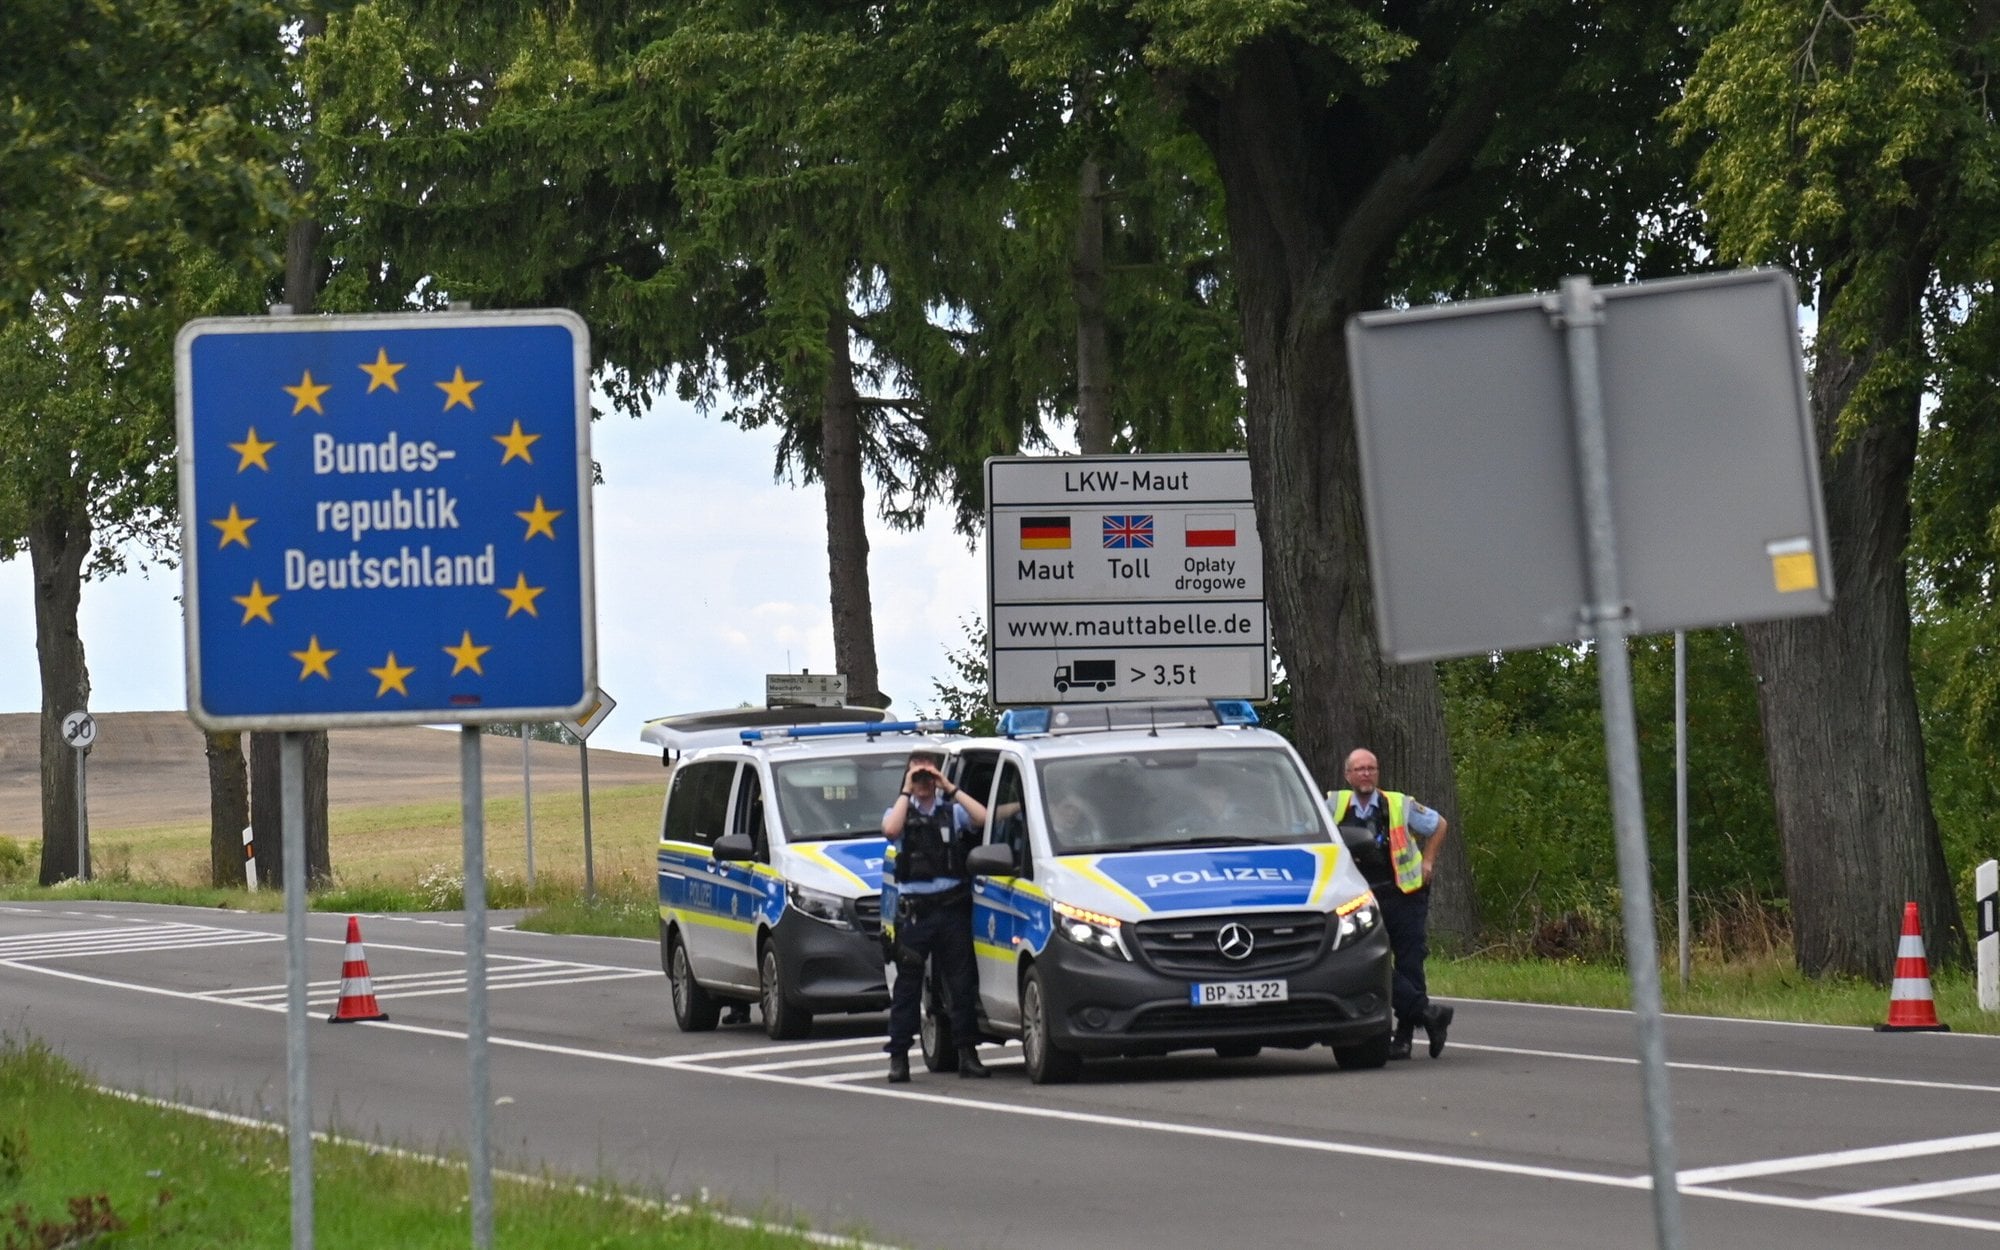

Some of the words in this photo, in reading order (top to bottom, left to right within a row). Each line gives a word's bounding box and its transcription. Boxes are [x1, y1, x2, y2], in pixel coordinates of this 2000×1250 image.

[313, 431, 456, 475] Bundes-
[1065, 470, 1189, 492] LKW-Maut
[316, 487, 460, 542] republik
[284, 543, 496, 591] Deutschland
[1018, 559, 1075, 580] Maut
[1107, 558, 1150, 579] Toll
[1175, 575, 1246, 594] drogowe
[1008, 613, 1252, 637] www.mauttabelle.de
[68, 720, 91, 739] 30
[1146, 867, 1293, 889] POLIZEI
[1205, 985, 1227, 1001] BP
[1236, 982, 1281, 1000] 31-22
